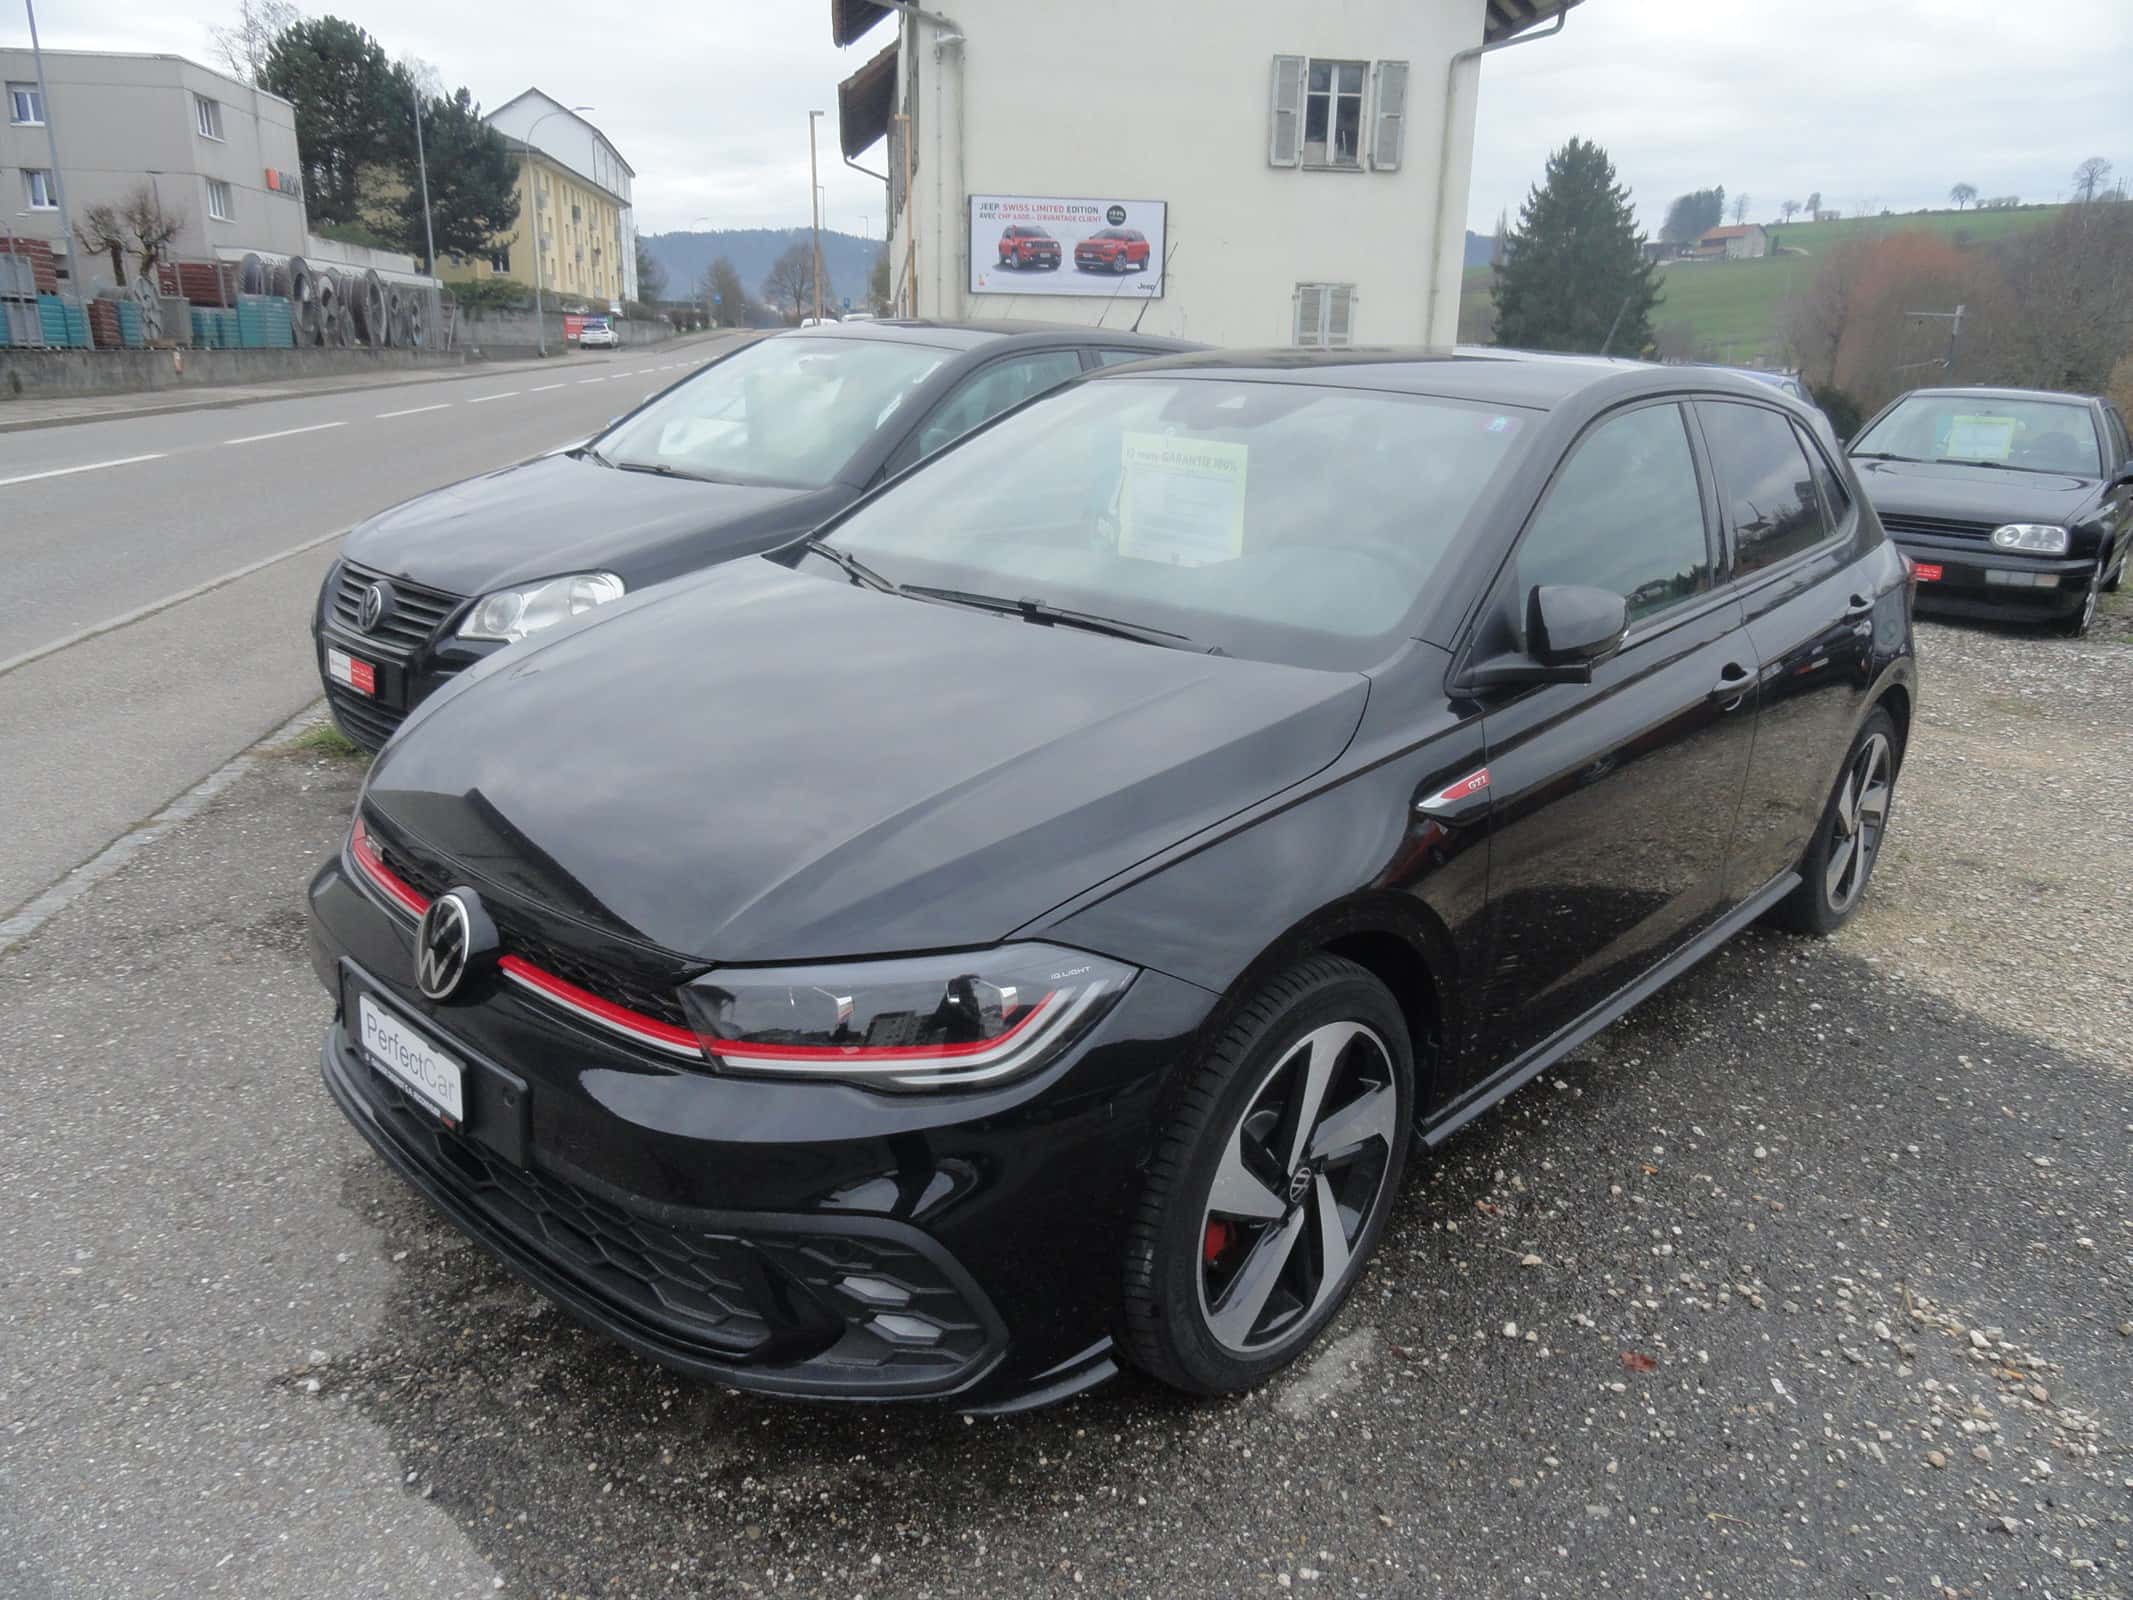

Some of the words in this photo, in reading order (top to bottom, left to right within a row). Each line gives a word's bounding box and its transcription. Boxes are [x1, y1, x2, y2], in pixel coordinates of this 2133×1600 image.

[1002, 204, 1030, 212] SWISS
[1031, 204, 1065, 213] LIMITED
[1066, 205, 1099, 214] EDITION
[1078, 215, 1102, 223] CLIENT
[1161, 451, 1214, 468] GARANTIE
[1468, 776, 1486, 790] GTI
[366, 1011, 456, 1101] PerfectCar
